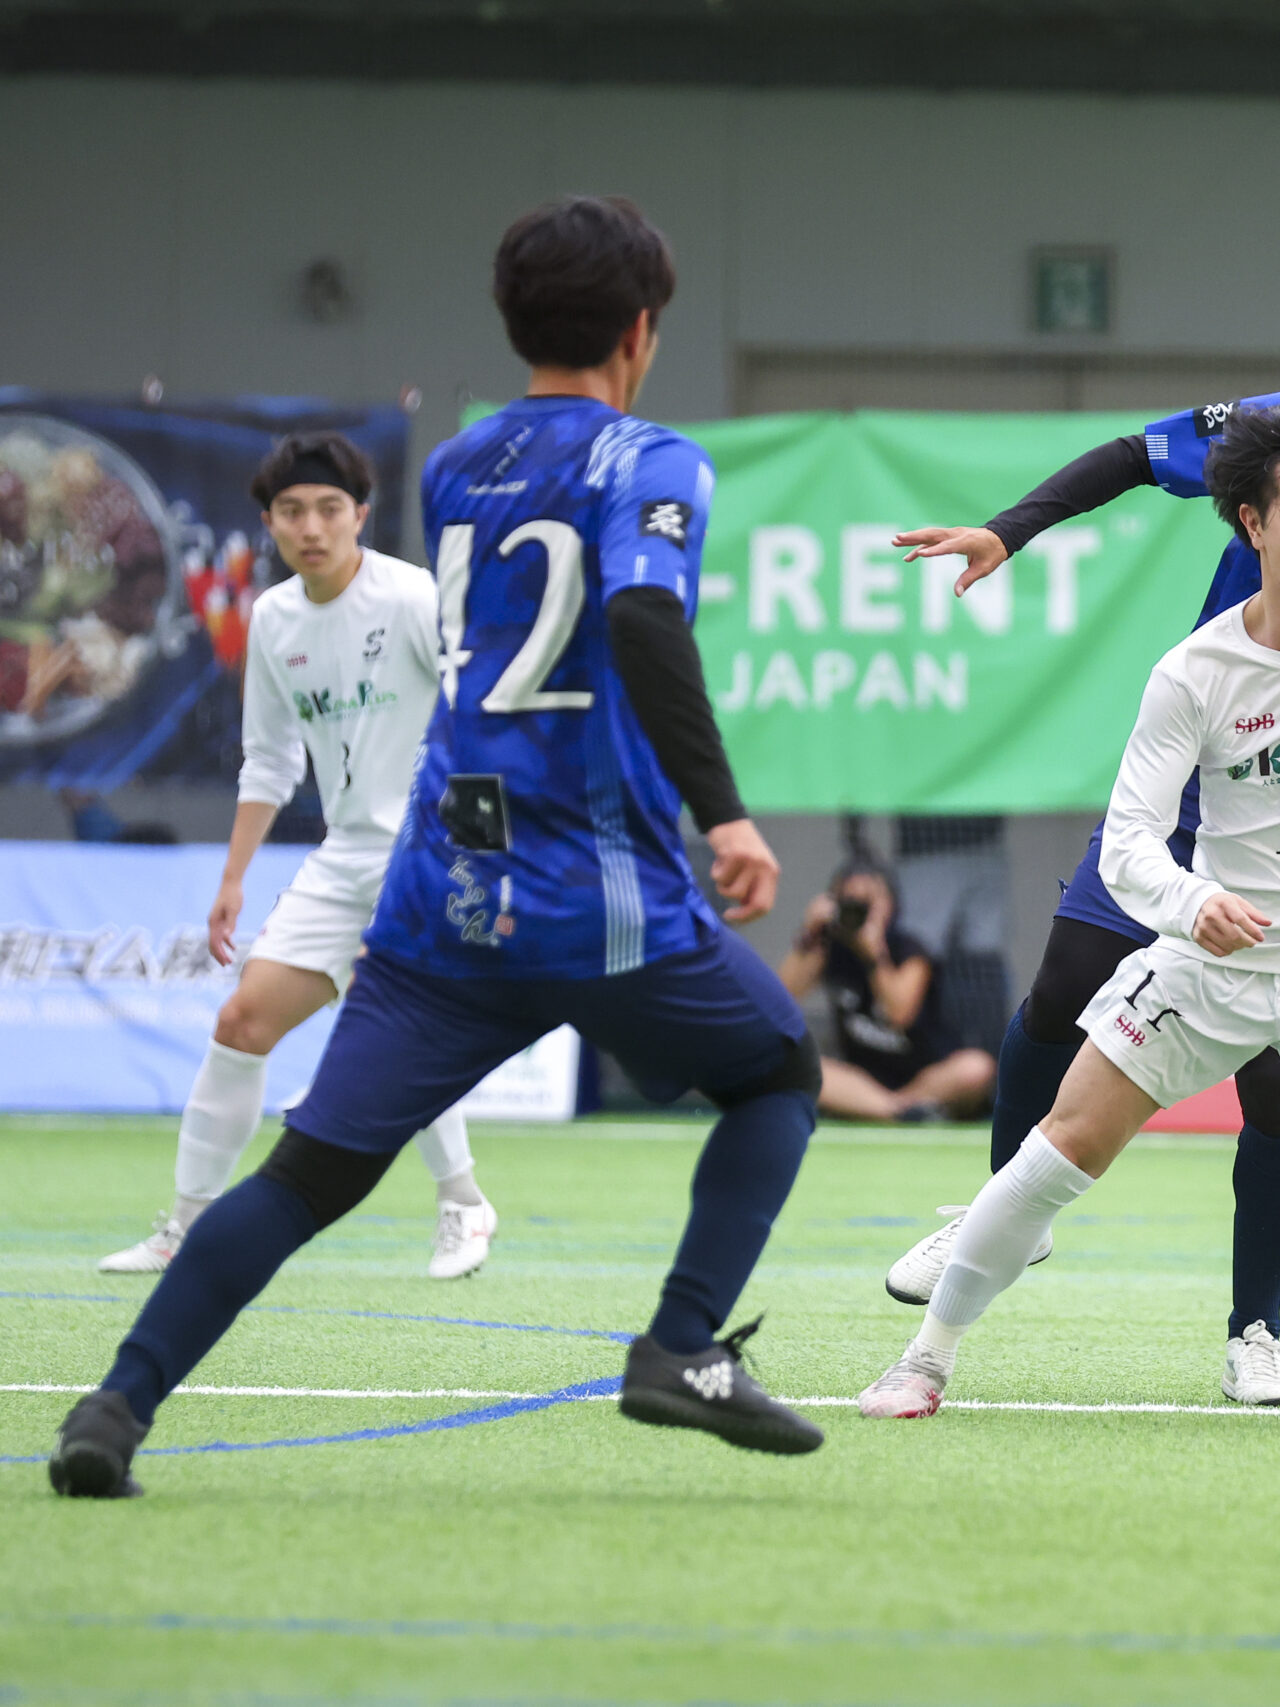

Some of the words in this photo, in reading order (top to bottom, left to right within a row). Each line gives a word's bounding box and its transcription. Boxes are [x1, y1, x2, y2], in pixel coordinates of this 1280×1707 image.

[719, 650, 970, 712] JAPAN
[1235, 713, 1275, 734] SDB
[1114, 1014, 1146, 1047] SDB
